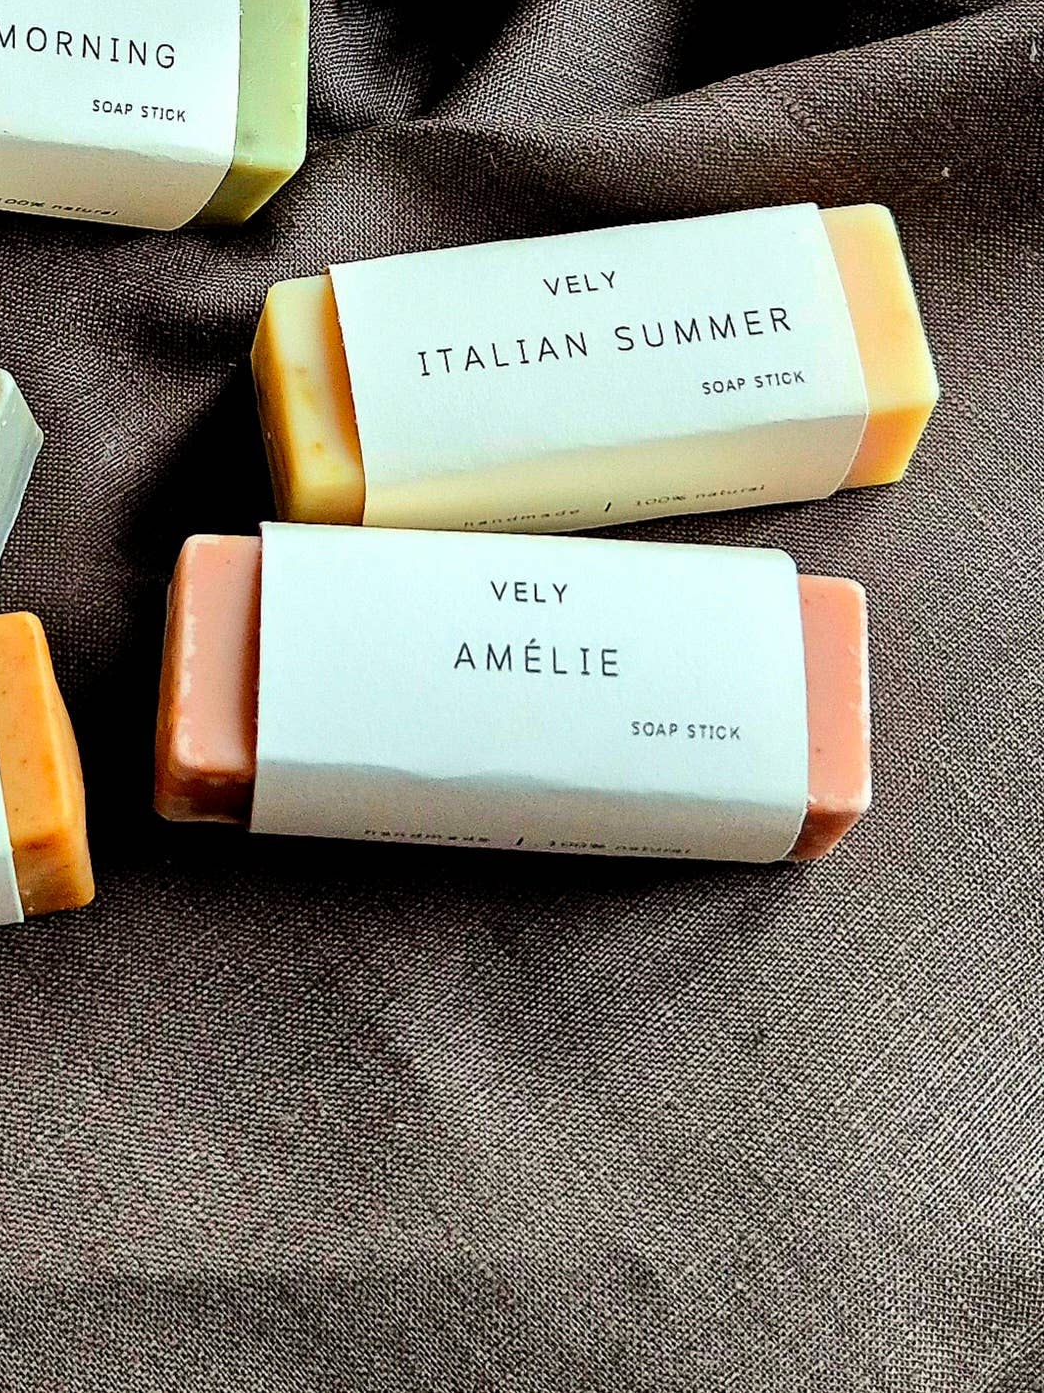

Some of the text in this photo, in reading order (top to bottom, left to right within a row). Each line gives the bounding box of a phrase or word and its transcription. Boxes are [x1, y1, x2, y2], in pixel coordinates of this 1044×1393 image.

[92, 99, 185, 122] SOAP STICK
[543, 271, 615, 296] VELY
[418, 308, 791, 376] ITALIAN SUMMER
[702, 371, 804, 395] SOAP STICK
[490, 581, 567, 603] VELY
[454, 638, 618, 677] AMÉLIE
[631, 721, 739, 740] SOAP STICK
